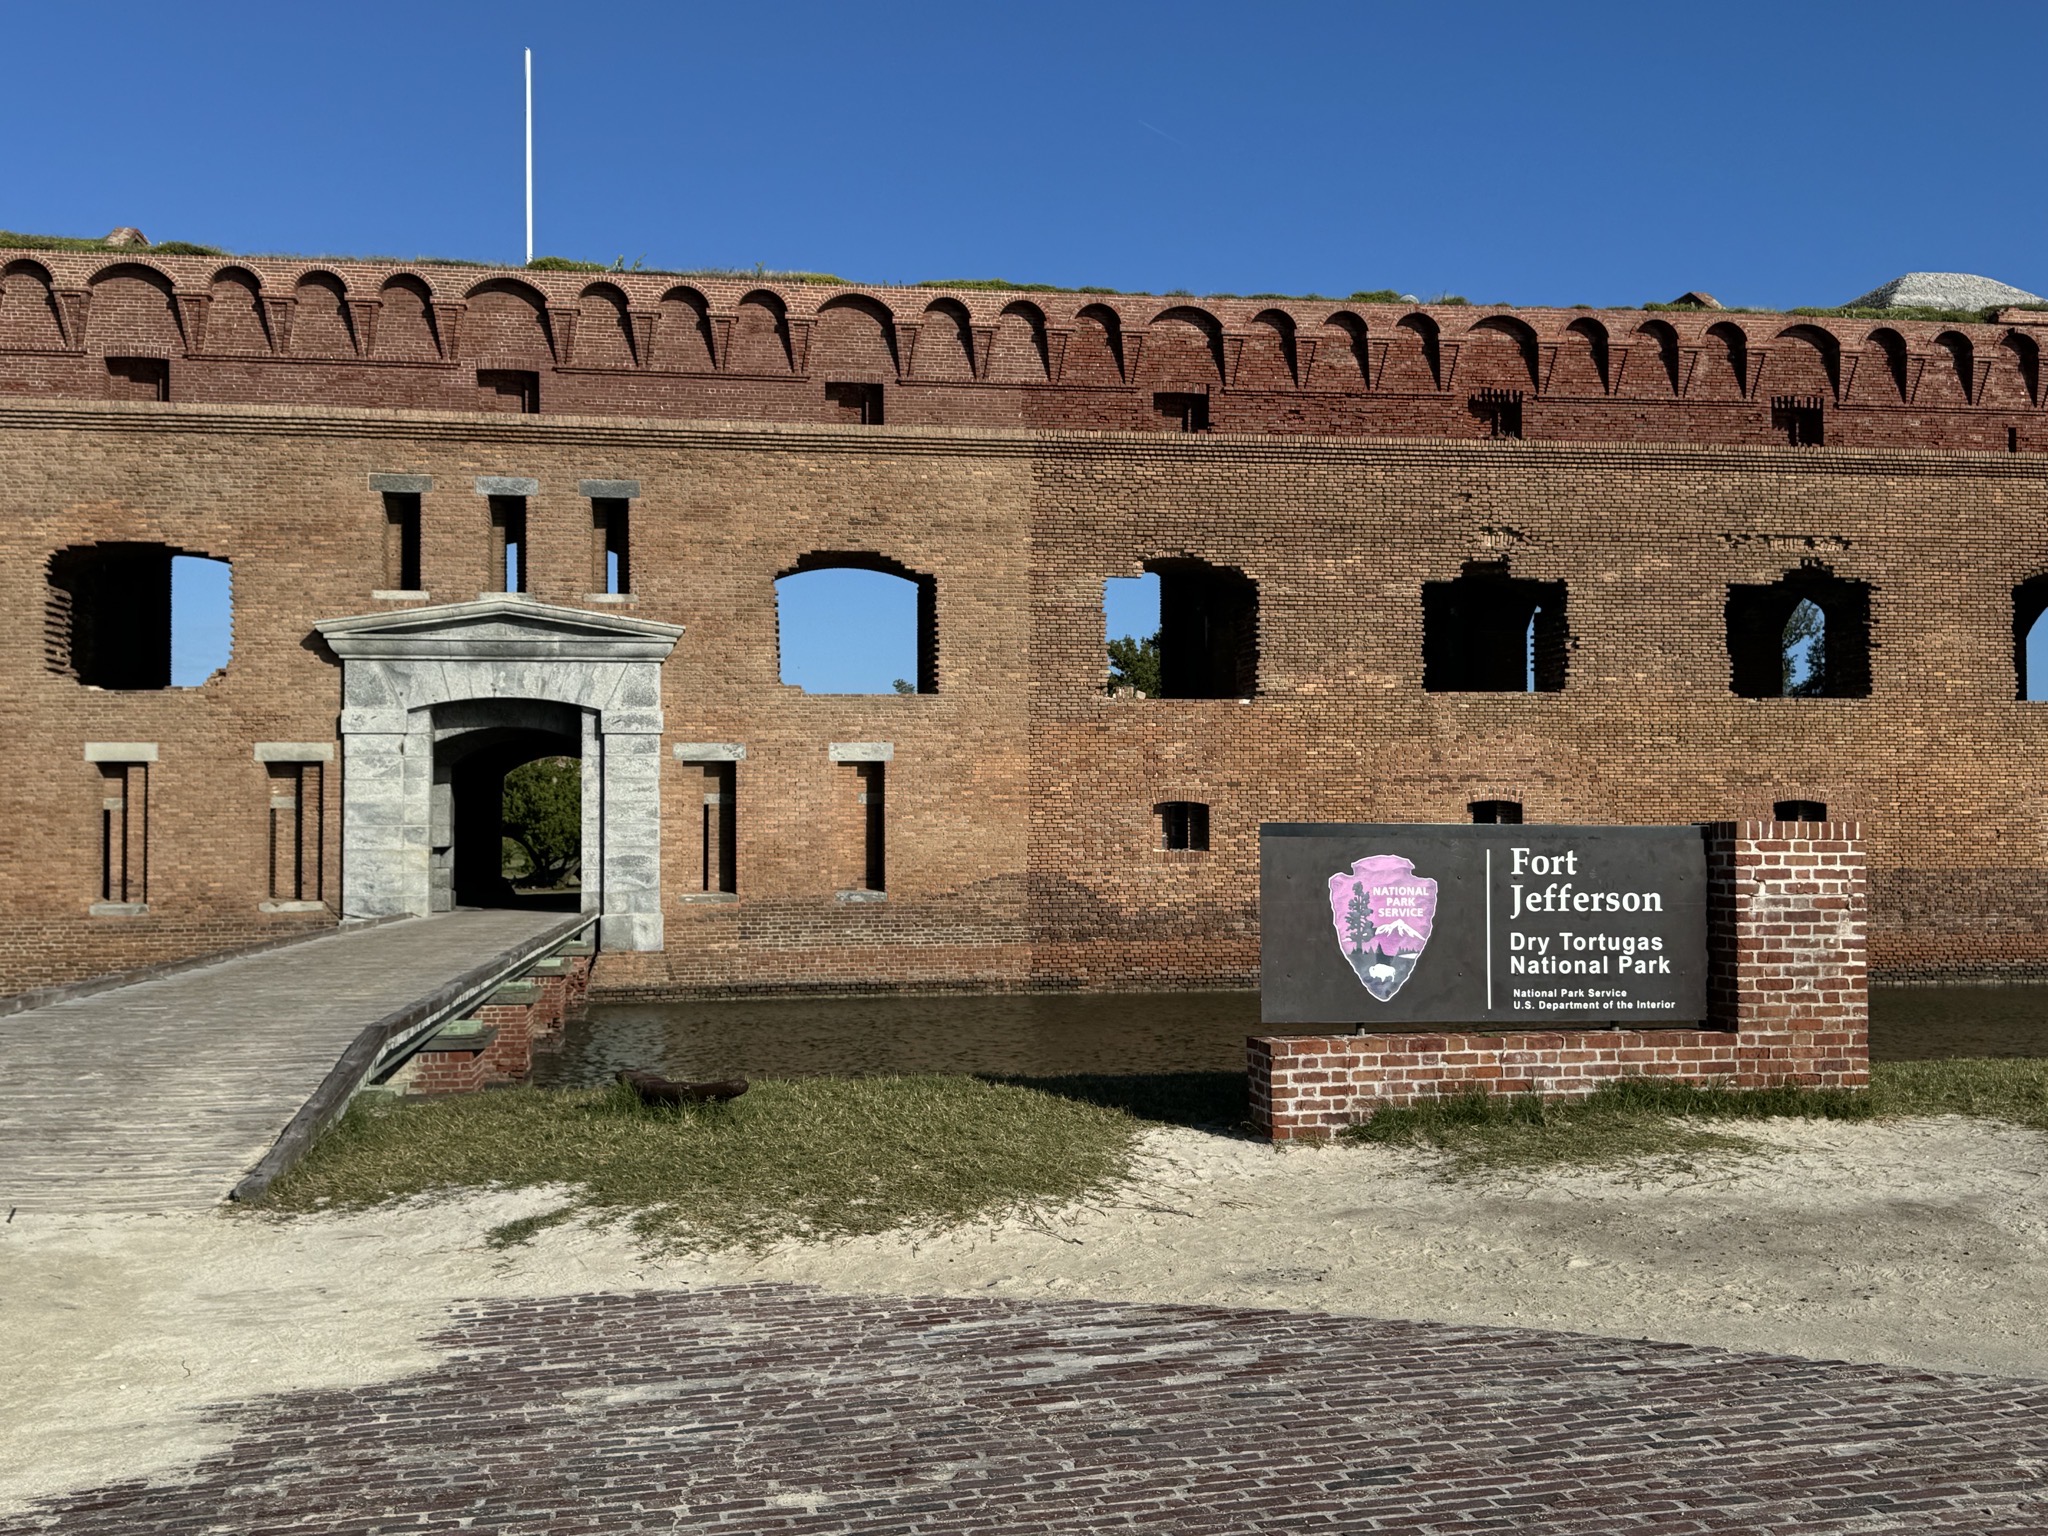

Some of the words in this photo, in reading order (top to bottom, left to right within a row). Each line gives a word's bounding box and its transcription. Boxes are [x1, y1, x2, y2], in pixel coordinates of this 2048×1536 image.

[1510, 847, 1578, 875] Fort
[1372, 886, 1429, 896] NATIONAL
[1386, 897, 1416, 907] PARK
[1510, 883, 1664, 920] Jefferson
[1378, 908, 1424, 917] SERVICE
[1510, 932, 1550, 956] Dry
[1558, 932, 1664, 956] Tortugas
[1510, 956, 1609, 975] National
[1618, 956, 1671, 974] Park
[1513, 988, 1558, 998] National
[1560, 988, 1585, 998] Park
[1587, 988, 1628, 998] Service
[1513, 1000, 1535, 1010] U.S.
[1538, 1000, 1600, 1012] Department
[1602, 1000, 1614, 1010] of
[1616, 1000, 1634, 1010] the
[1636, 1000, 1676, 1009] Interior
